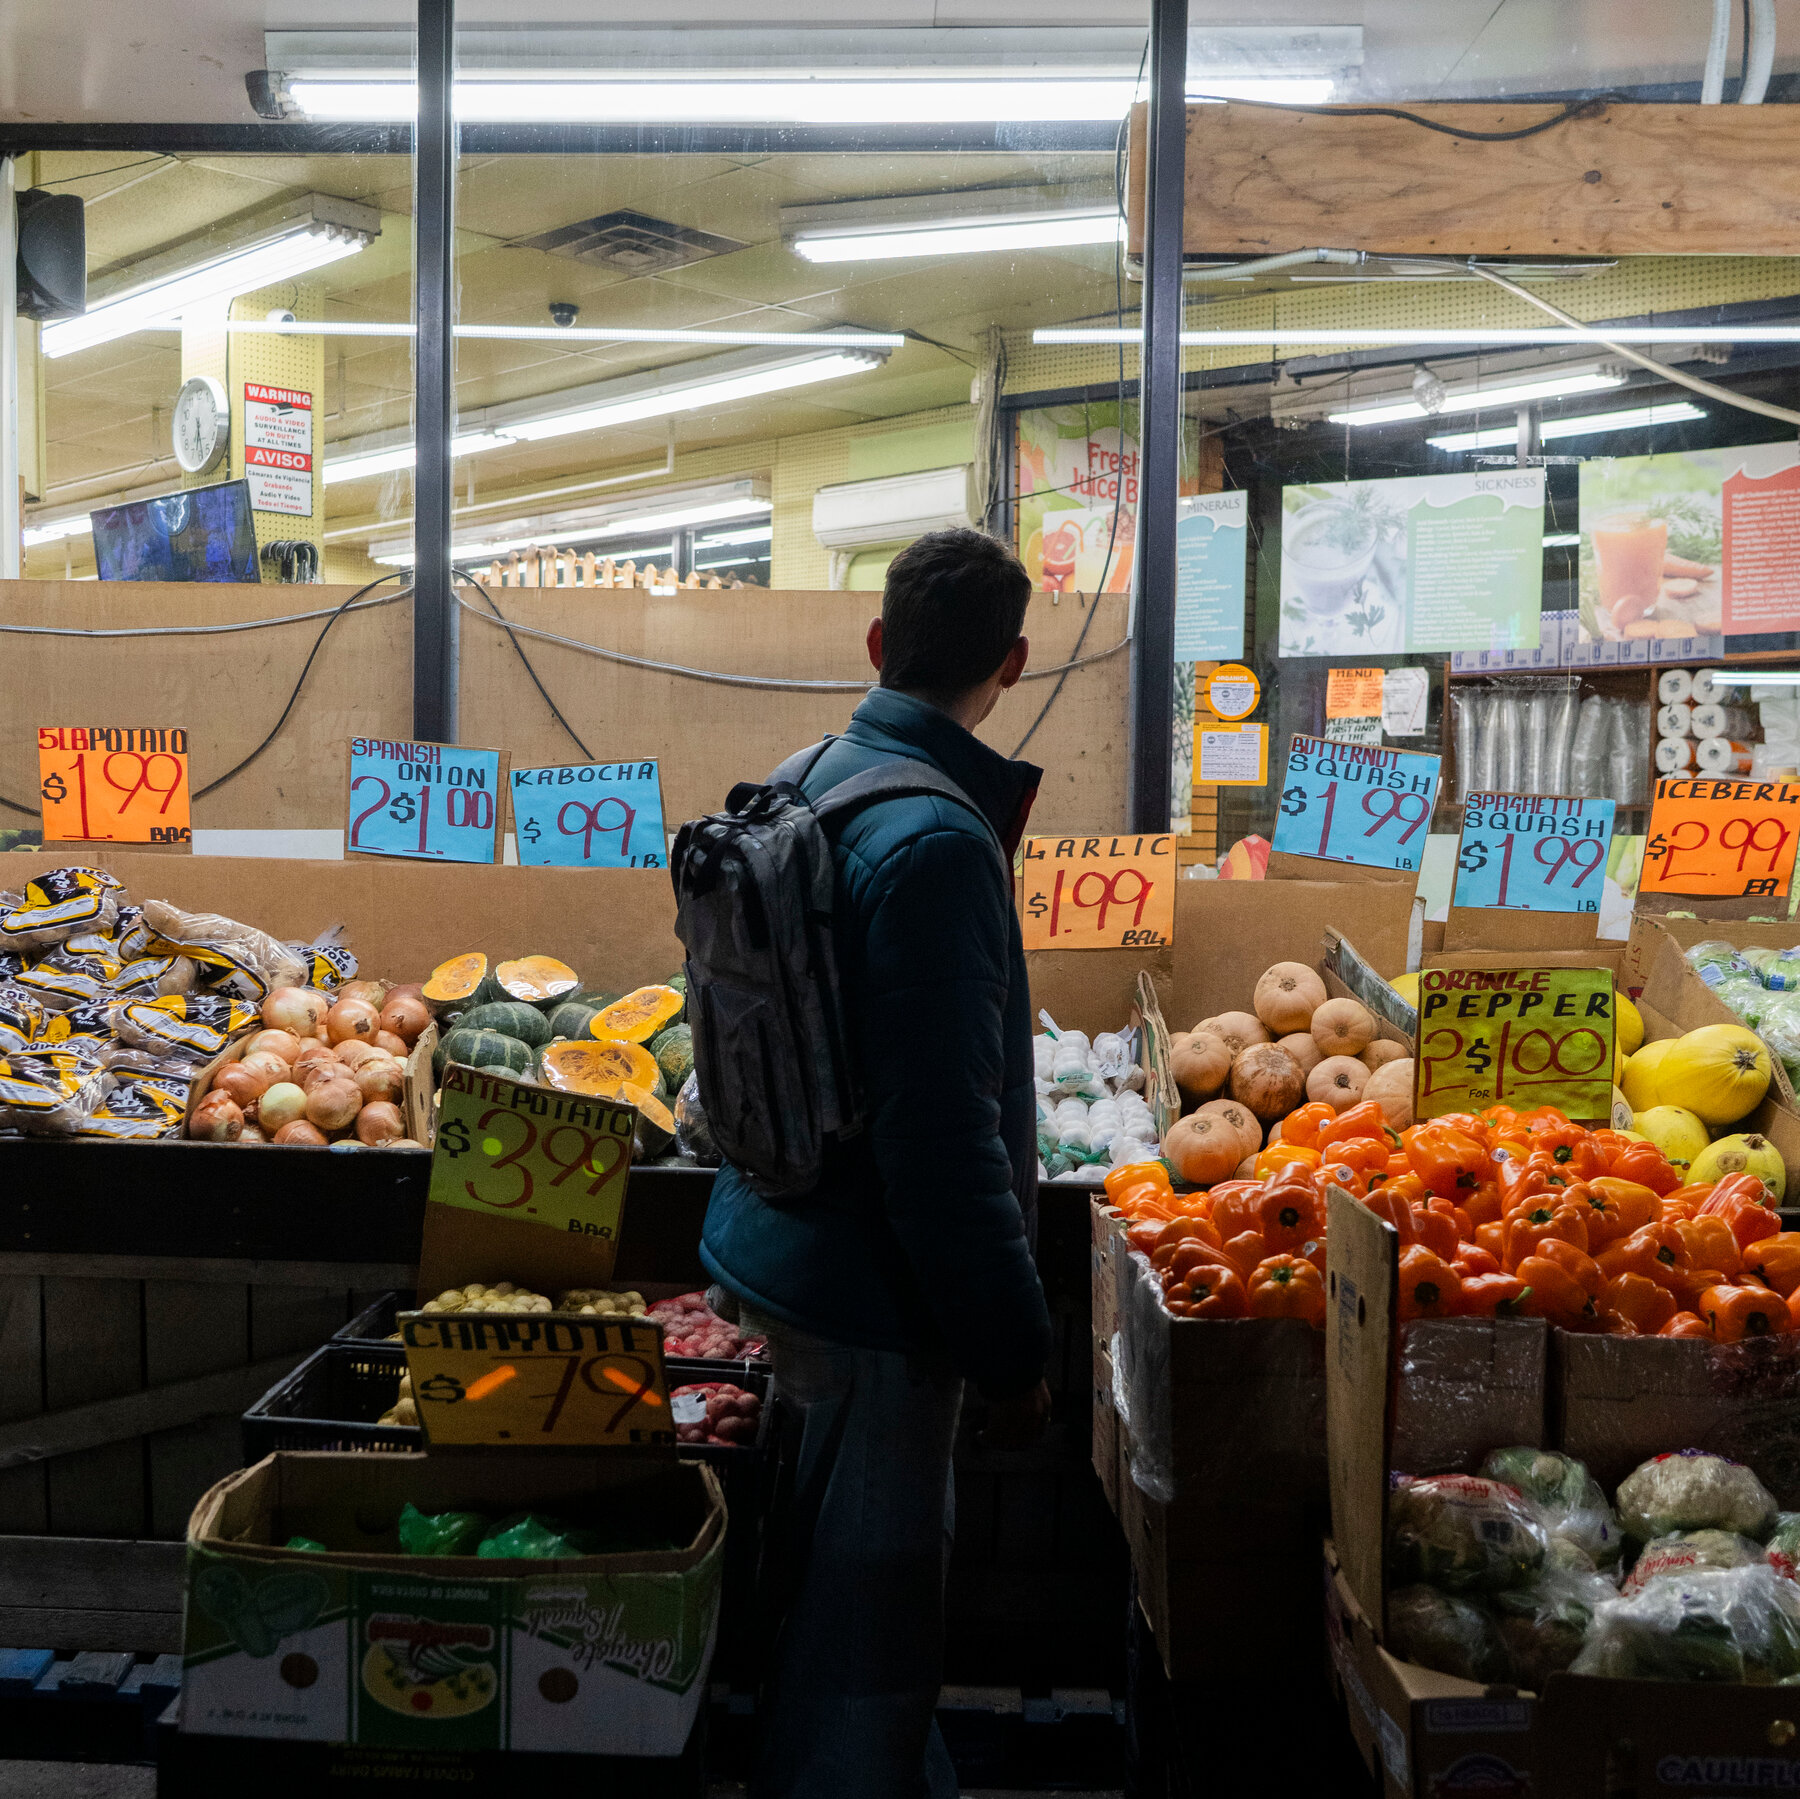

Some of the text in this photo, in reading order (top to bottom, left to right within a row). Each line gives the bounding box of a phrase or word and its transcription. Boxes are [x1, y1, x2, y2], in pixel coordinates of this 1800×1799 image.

[248, 385, 311, 406] WARNING
[254, 422, 306, 435] SURVEILLANCE
[255, 415, 277, 424] AUDIO
[285, 419, 306, 428] VIDEO
[280, 440, 302, 449] TIMES
[253, 450, 306, 469] AVISO
[263, 481, 293, 491] Grabando
[282, 475, 310, 484] Vigilancia
[1070, 467, 1118, 501] Juice
[1474, 476, 1537, 492] SICKNESS
[260, 490, 277, 498] Audio
[280, 502, 303, 511] Tiempo
[1186, 498, 1240, 514] MINERALS
[1336, 669, 1373, 678] MENU
[351, 738, 441, 765] SPANISH
[1291, 736, 1403, 770] BUTTERNUT
[398, 763, 485, 789] ONION
[515, 762, 654, 788] KABOCHA
[1288, 753, 1431, 795] SQUASH
[41, 751, 183, 840] $1.99
[1657, 780, 1800, 804] ICEBERG
[1466, 793, 1584, 817] SPAGHETTI
[1281, 781, 1430, 861] $1.99
[1464, 811, 1605, 838] SQUASH
[150, 826, 191, 843] BAG
[1025, 836, 1170, 860] GARLIC
[1644, 817, 1791, 881] $2.99
[1395, 856, 1413, 870] LB
[1458, 833, 1605, 909] $1.99
[1742, 878, 1780, 896] EA
[1026, 868, 1154, 938] $1.99
[1577, 900, 1597, 912] LB
[1121, 929, 1167, 946] BAG
[1423, 970, 1551, 992] ORANGE
[1423, 992, 1611, 1019] PEPPER
[1468, 1088, 1490, 1098] FOR
[510, 1087, 632, 1137] POTATO
[439, 1108, 628, 1214] $3.99
[567, 1218, 613, 1240] BAG
[404, 1320, 652, 1351] CHAYOTE
[527, 1602, 604, 1638] Squash
[571, 1633, 674, 1679] Chayote
[372, 1765, 420, 1780] FARMS
[422, 1767, 475, 1782] CLOVER
[1659, 1760, 1800, 1786] CAULIFL
